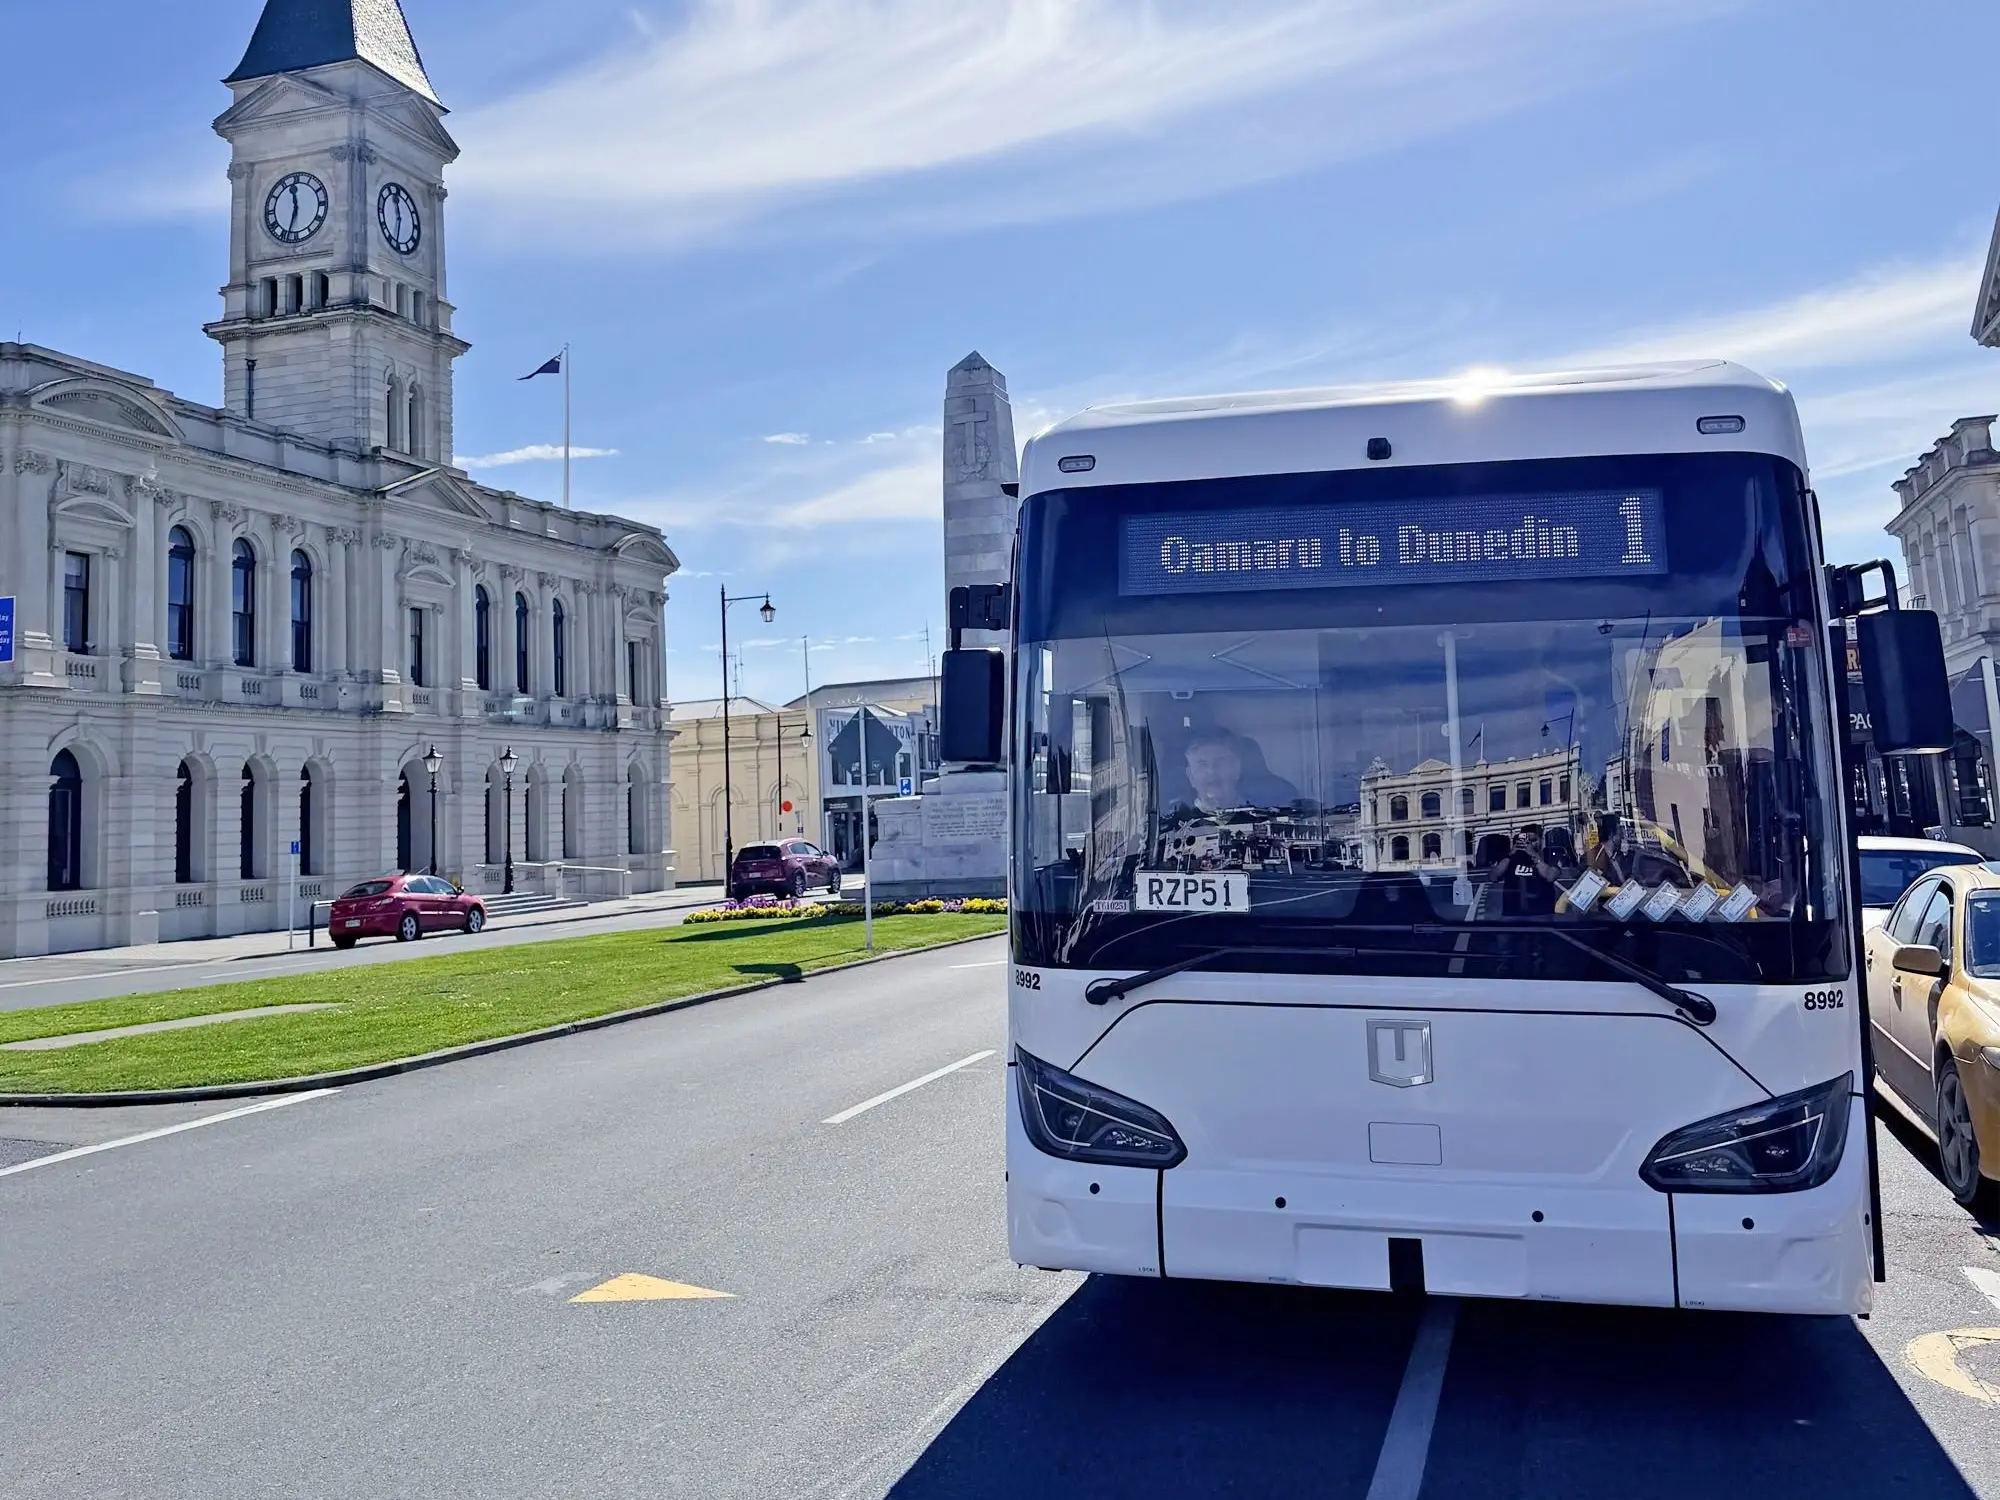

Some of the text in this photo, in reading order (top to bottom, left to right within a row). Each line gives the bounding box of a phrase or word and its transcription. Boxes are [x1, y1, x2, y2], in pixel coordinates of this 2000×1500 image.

[1160, 496, 1652, 574] Oamaru to Dunedin 1
[1148, 878, 1232, 907] RZP51
[1804, 989, 1844, 1011] 8992
